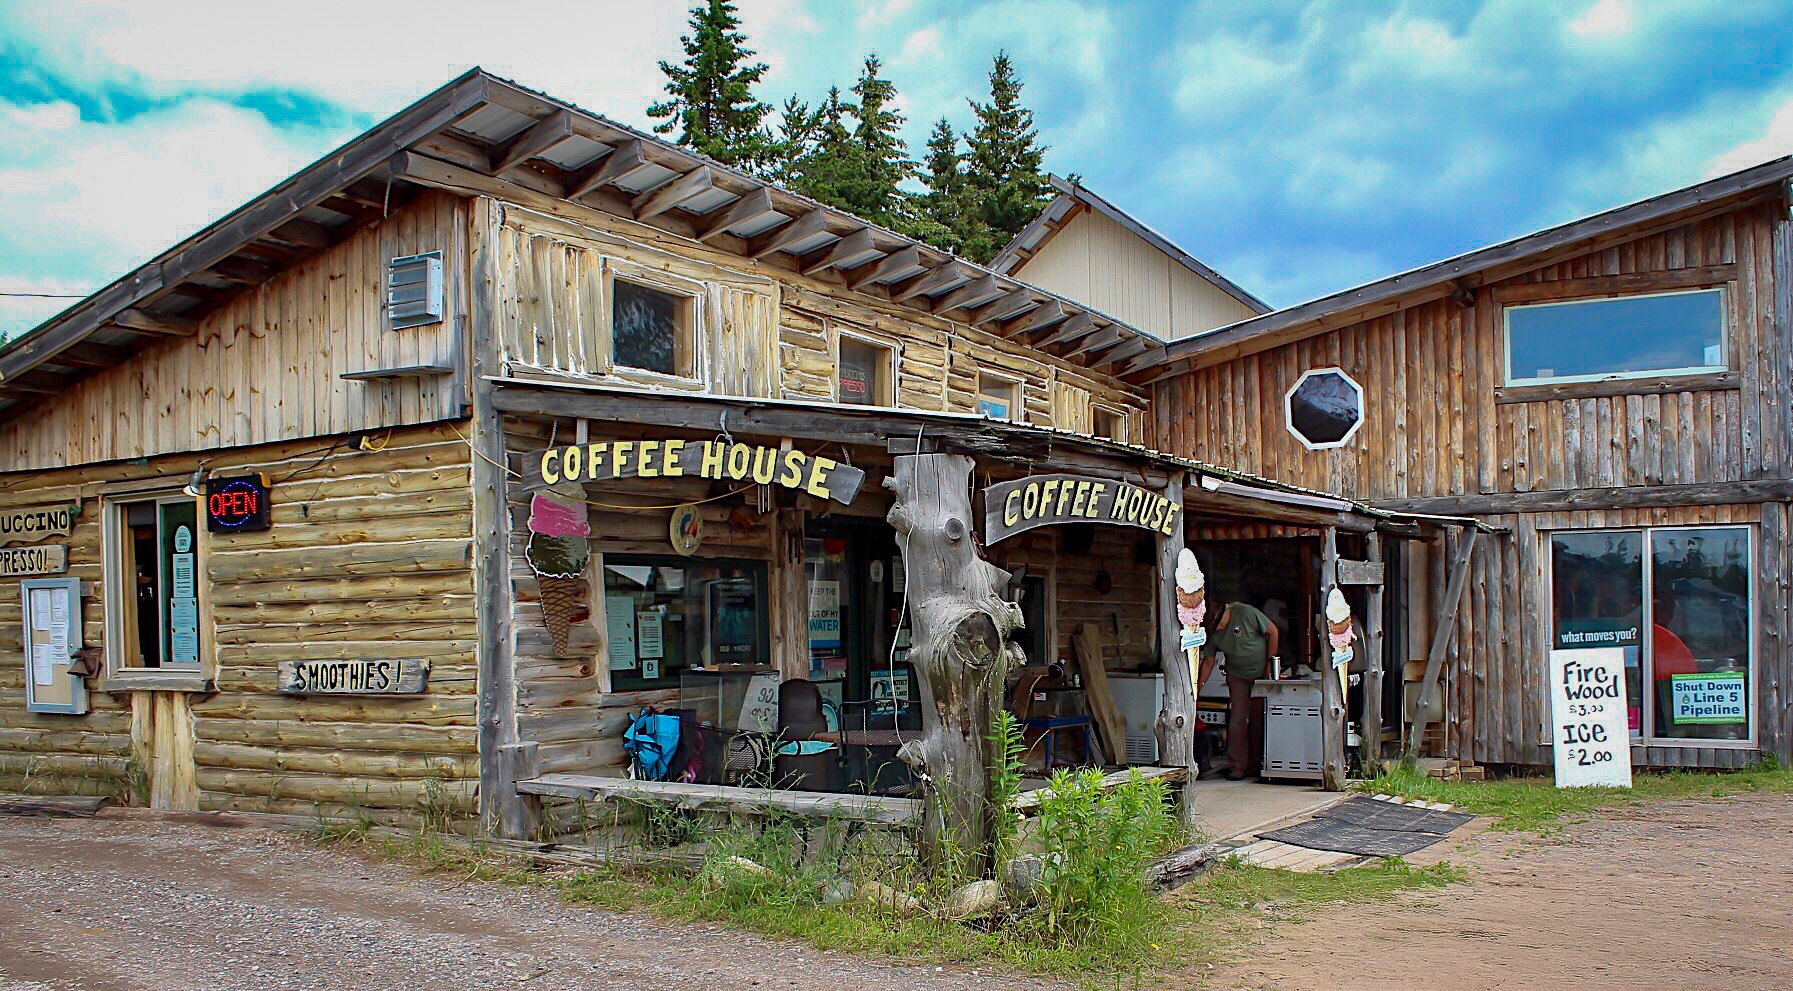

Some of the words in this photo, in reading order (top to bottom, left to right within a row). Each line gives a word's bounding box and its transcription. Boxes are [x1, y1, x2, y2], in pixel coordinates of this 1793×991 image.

[541, 439, 686, 485] COFFEE
[700, 440, 837, 500] HOUSE
[209, 491, 257, 516] OPEN
[1003, 479, 1105, 528] COFFEE
[1109, 485, 1182, 536] HOUSE
[1, 510, 68, 534] UCCINO
[809, 619, 839, 632] WATER
[821, 610, 830, 618] OF
[830, 610, 839, 618] MY
[1561, 630, 1584, 643] what
[1585, 631, 1614, 642] moves
[1615, 627, 1637, 643] you?
[295, 660, 402, 692] SMOOTHIES!
[1562, 660, 1609, 685] Fire
[1564, 675, 1619, 701] Wood
[1674, 682, 1704, 692] Shut
[1707, 682, 1742, 691] Down
[1694, 692, 1725, 703] Line
[1729, 692, 1738, 702] 5
[1681, 704, 1741, 717] Pipeline
